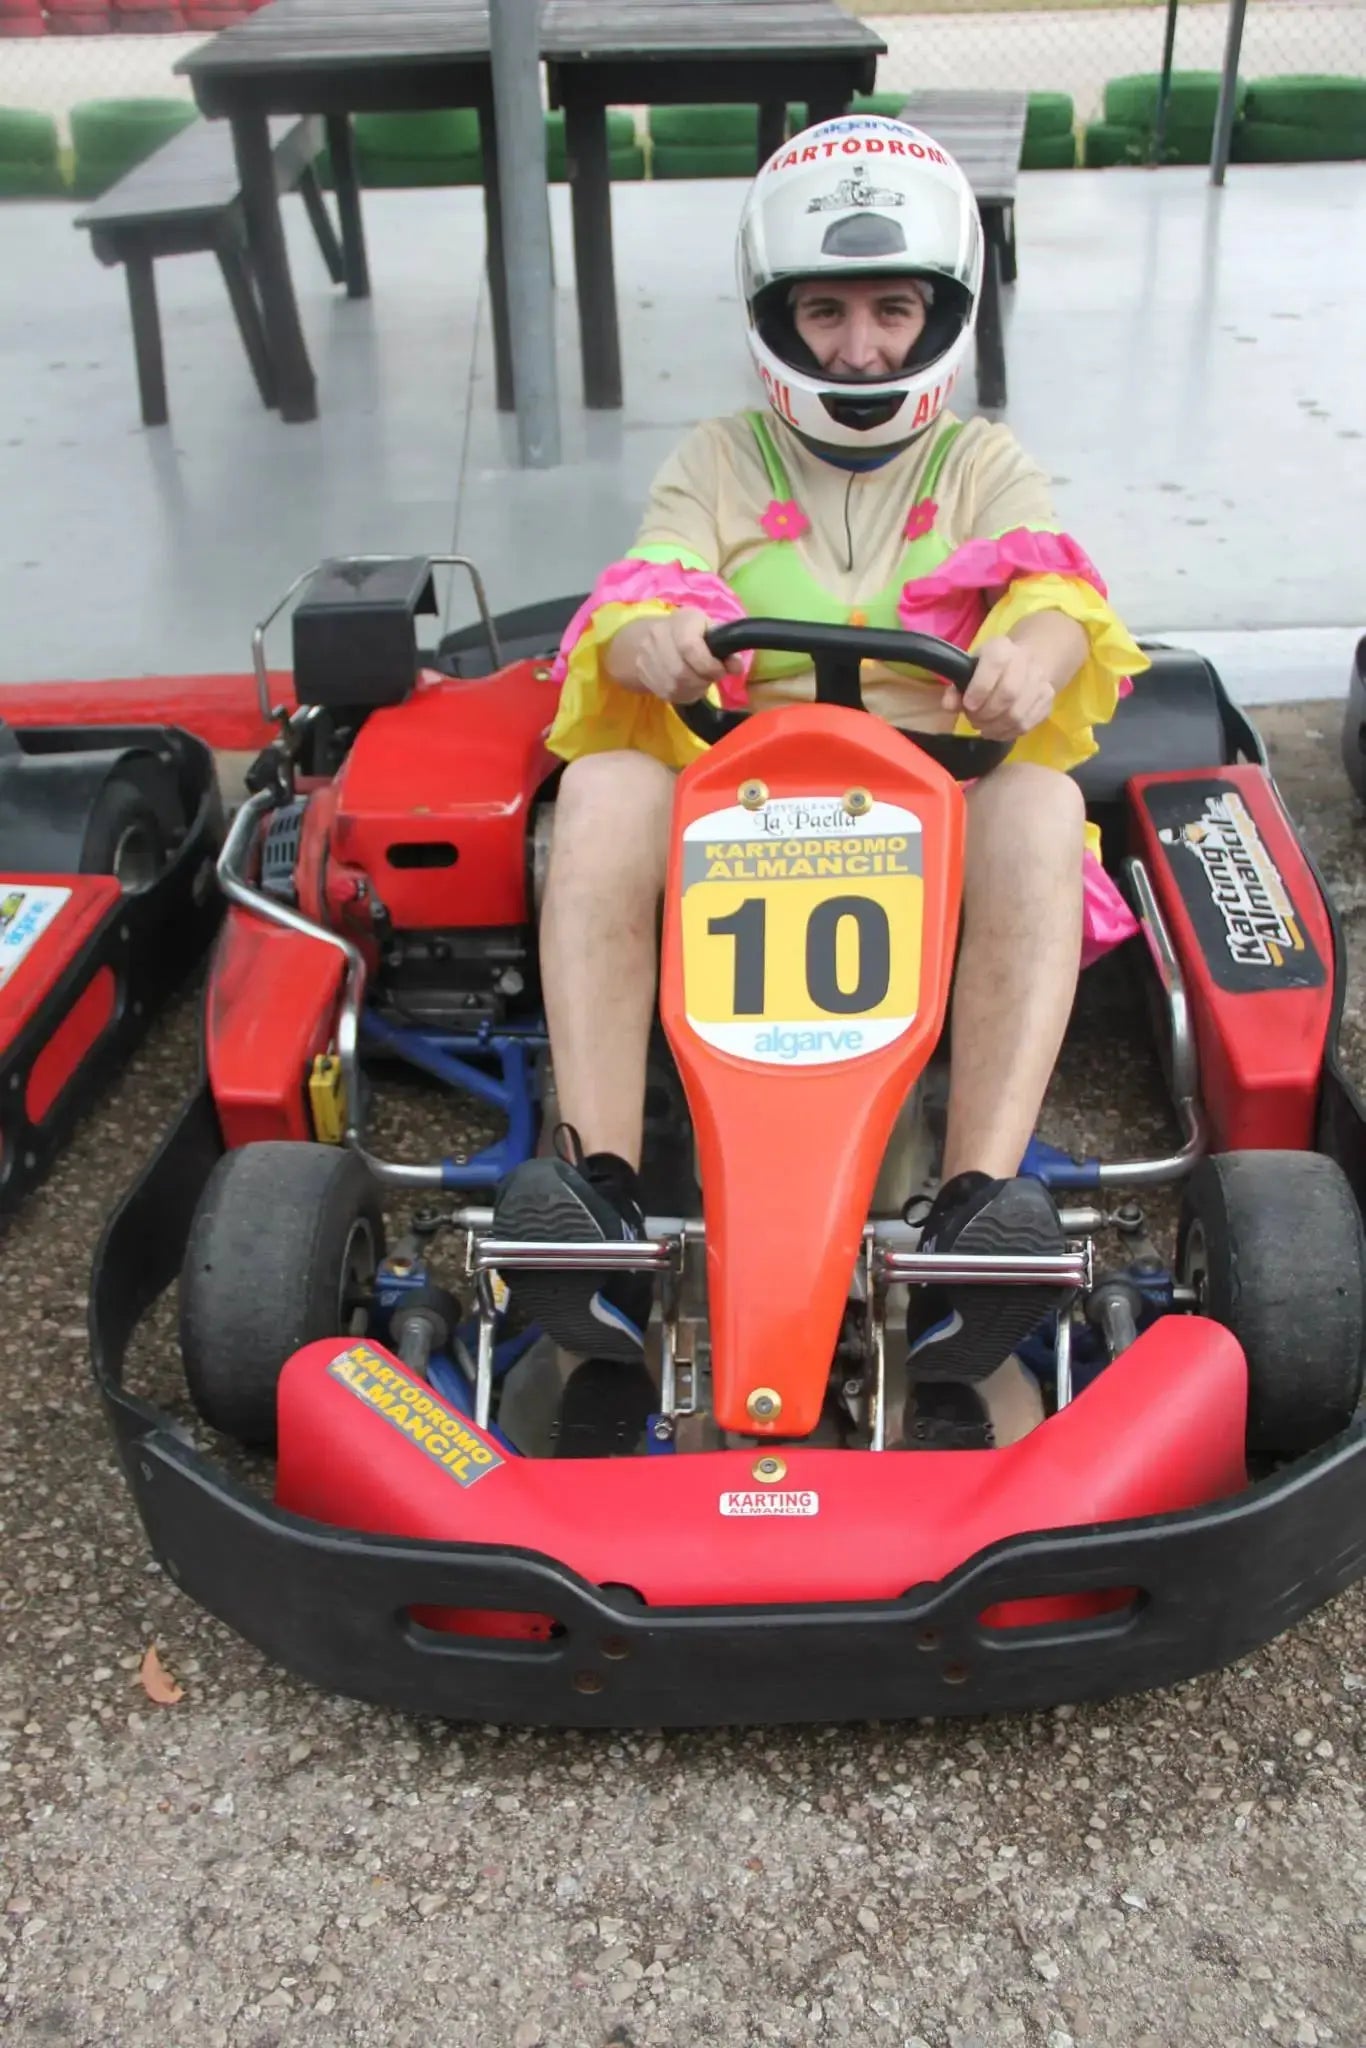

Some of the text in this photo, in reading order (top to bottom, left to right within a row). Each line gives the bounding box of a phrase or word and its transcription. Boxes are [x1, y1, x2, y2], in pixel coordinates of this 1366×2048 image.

[754, 808, 857, 836] La Paella
[705, 853, 909, 879] ALMANCIL
[1208, 817, 1288, 943] Almancil
[1200, 847, 1267, 961] Karting
[707, 894, 891, 1016] 10
[754, 1025, 863, 1060] algarve
[332, 1360, 469, 1481] ALMANCIL
[728, 1493, 812, 1507] KARTING
